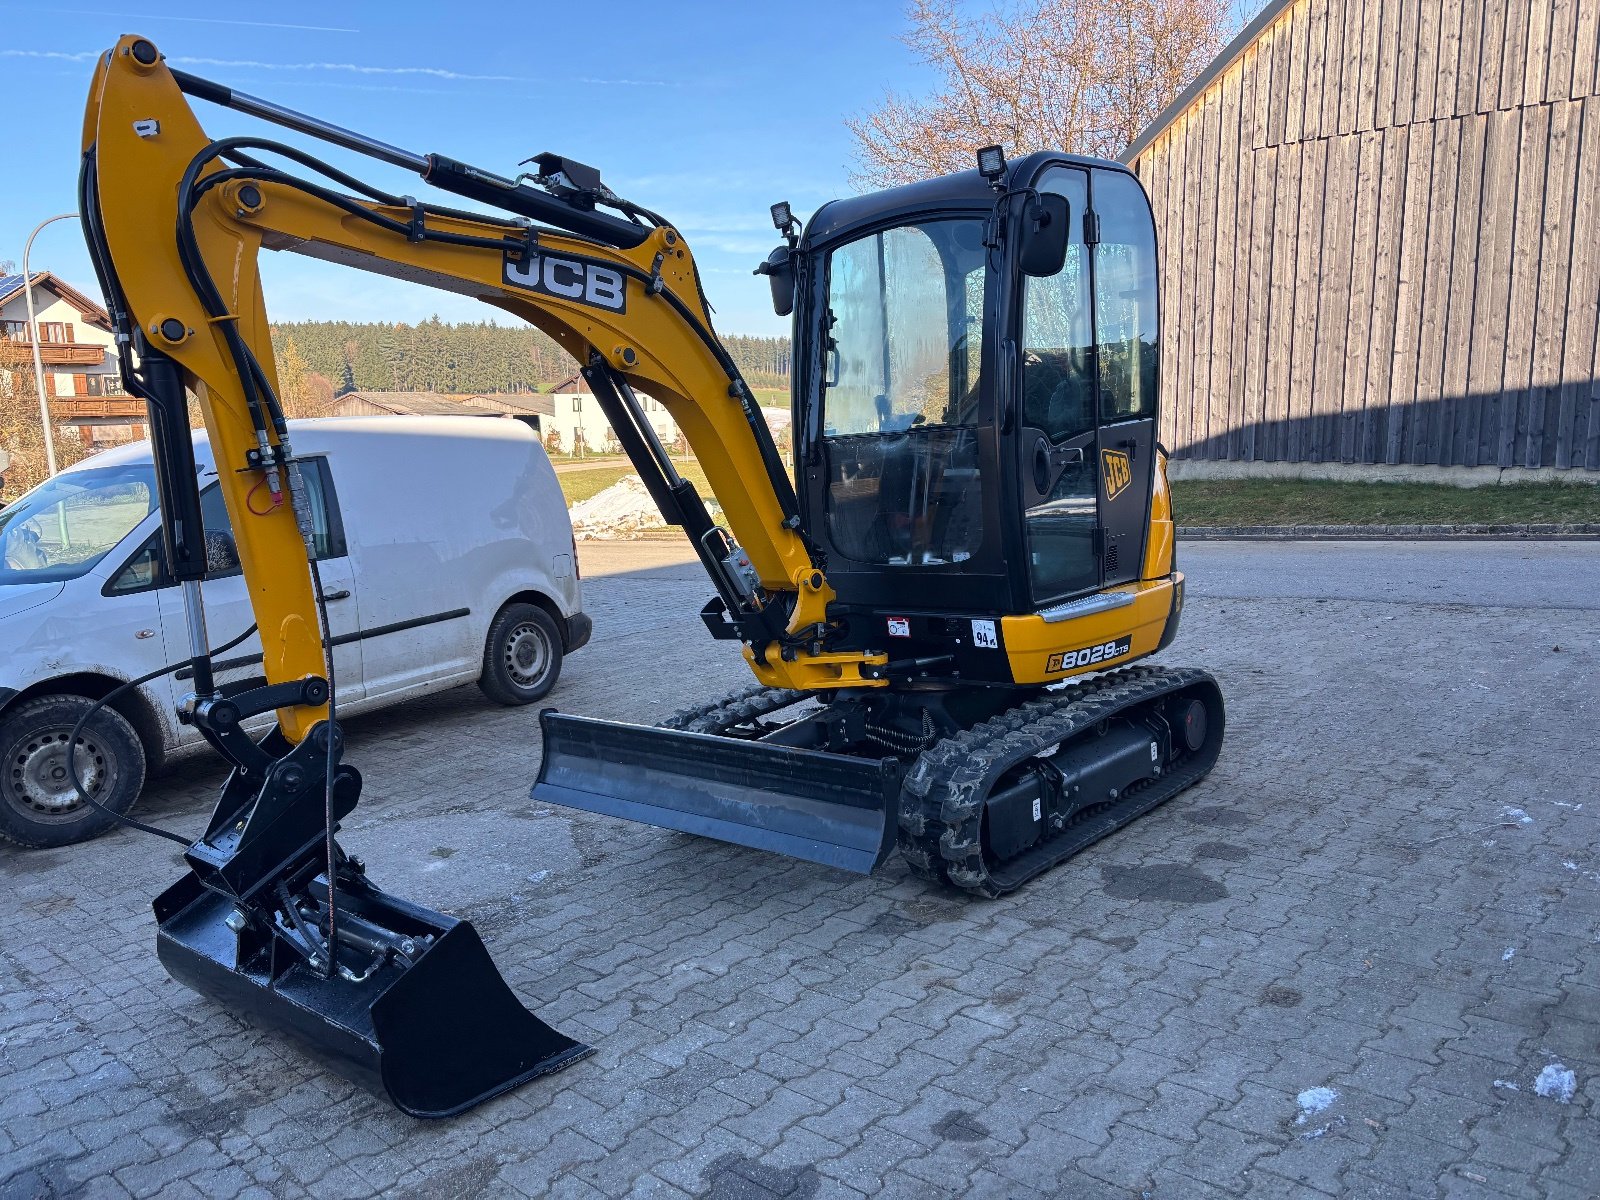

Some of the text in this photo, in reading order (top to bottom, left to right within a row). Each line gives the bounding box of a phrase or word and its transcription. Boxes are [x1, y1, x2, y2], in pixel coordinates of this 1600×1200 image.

[506, 255, 624, 309] JCB
[1105, 454, 1129, 495] JCB
[976, 631, 989, 646] 94
